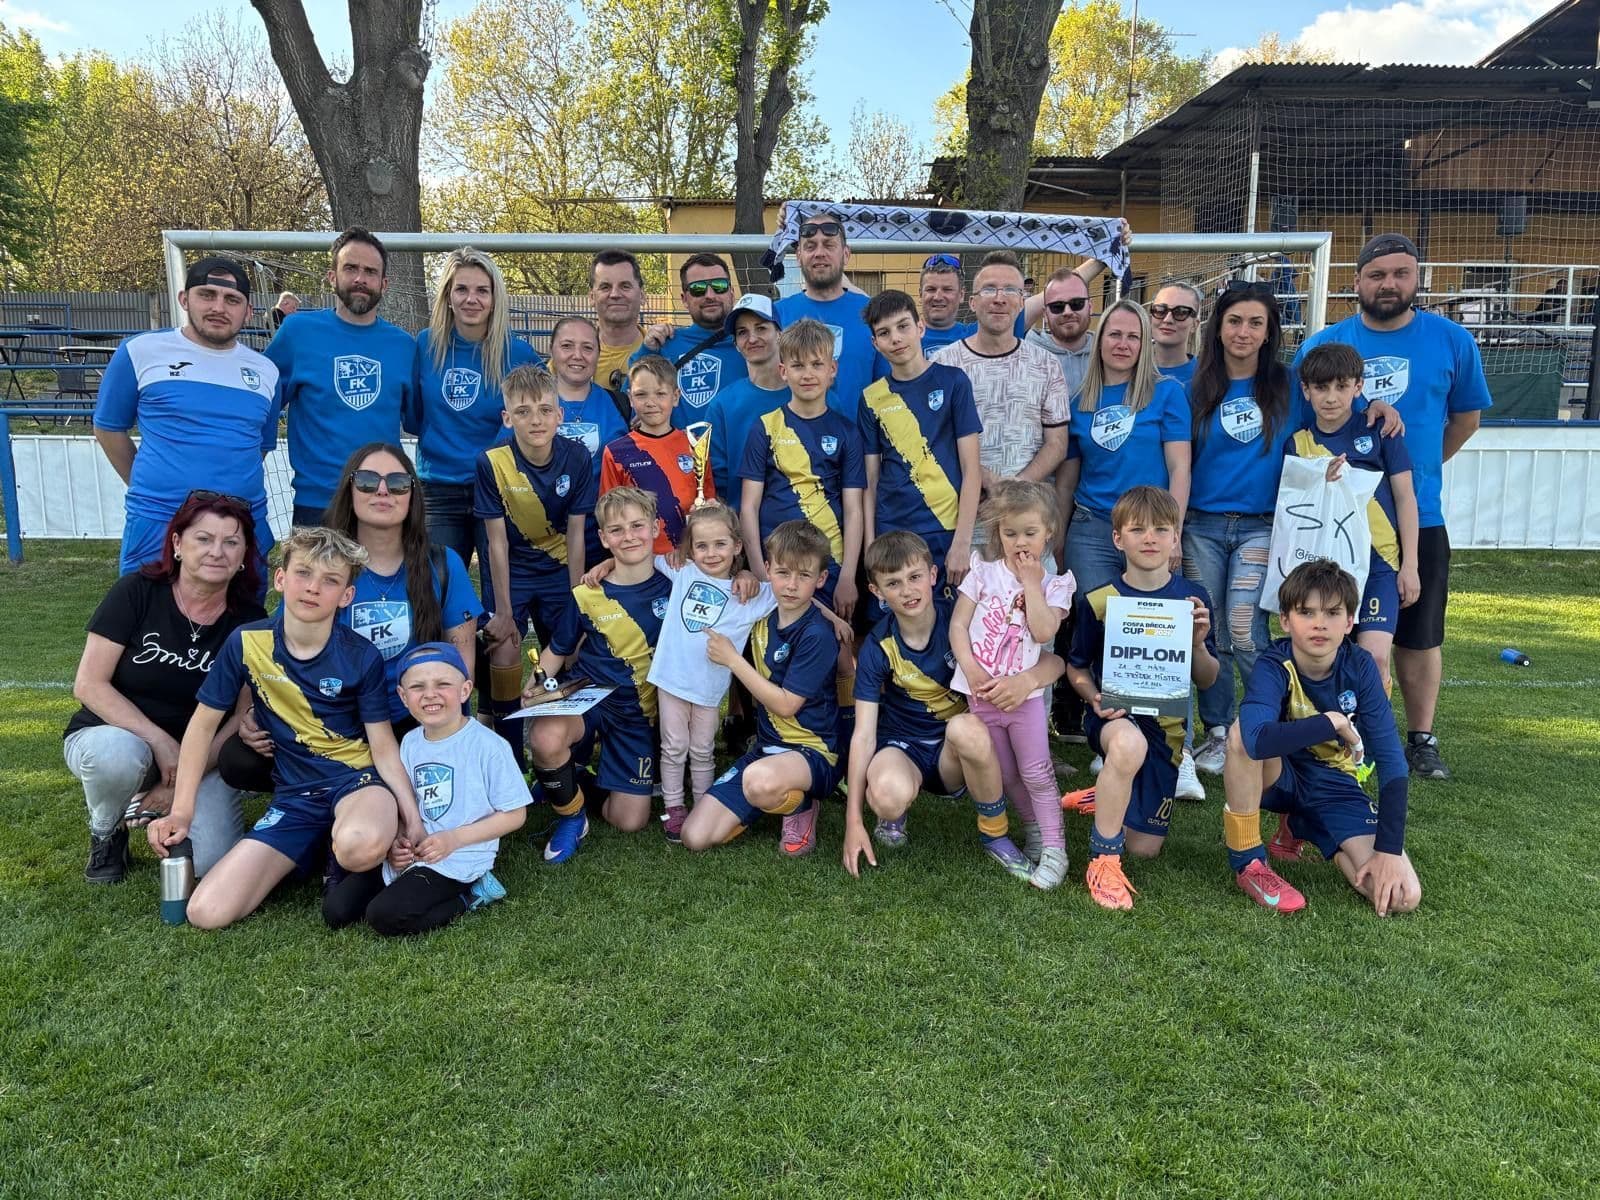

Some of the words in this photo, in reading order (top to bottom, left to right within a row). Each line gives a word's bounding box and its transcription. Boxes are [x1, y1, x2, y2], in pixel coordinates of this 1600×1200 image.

[350, 377, 367, 390] FK
[691, 375, 707, 388] FK
[1375, 375, 1394, 390] FK
[453, 386, 468, 395] FK
[1237, 411, 1255, 425] FK
[1104, 421, 1121, 434] FK
[693, 603, 711, 616] FK
[1369, 597, 1380, 616] 9
[371, 622, 393, 642] FK
[972, 605, 1005, 668] Barbie
[1122, 626, 1145, 635] CUP
[1110, 645, 1186, 664] DIPLOM
[638, 756, 652, 778] 12
[423, 785, 440, 801] FK
[1155, 797, 1173, 820] 10
